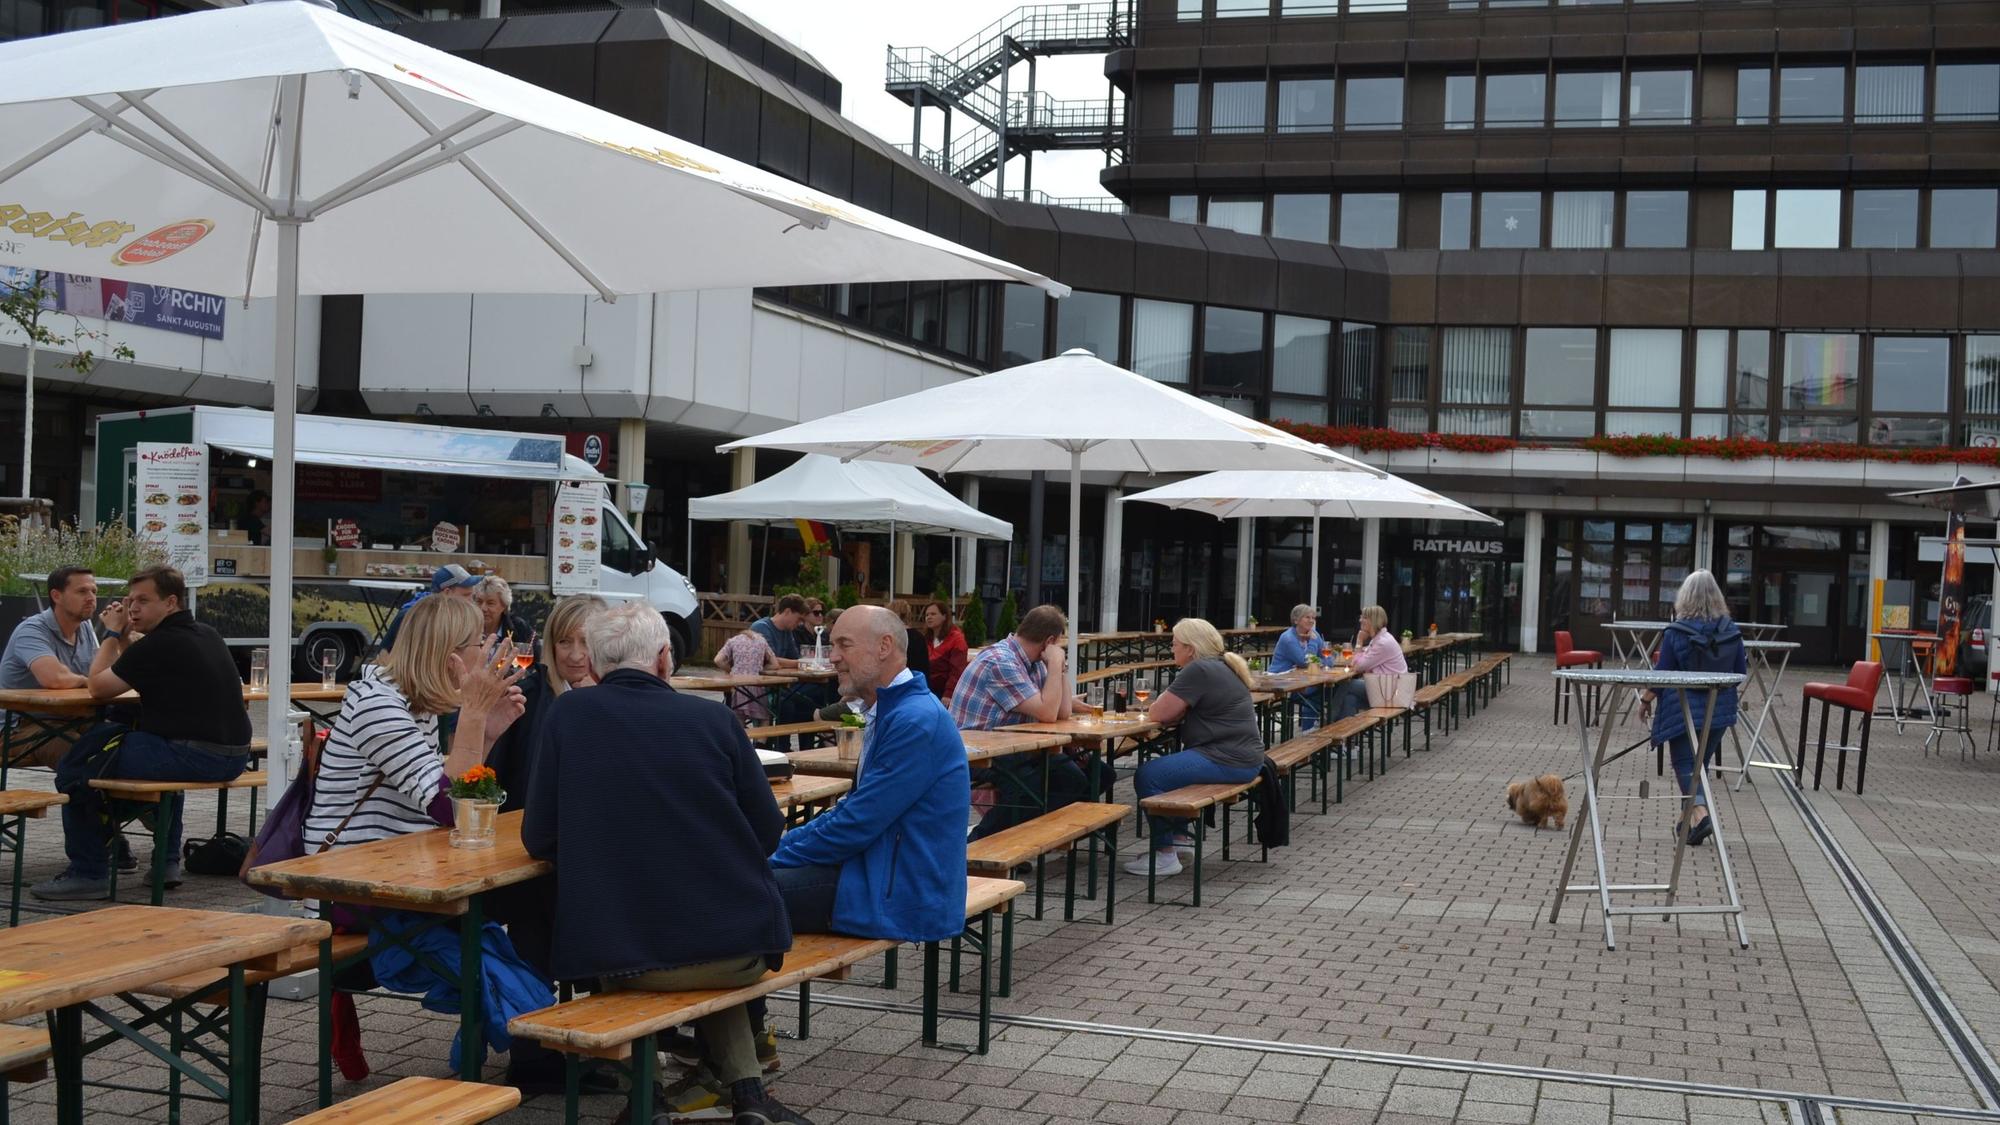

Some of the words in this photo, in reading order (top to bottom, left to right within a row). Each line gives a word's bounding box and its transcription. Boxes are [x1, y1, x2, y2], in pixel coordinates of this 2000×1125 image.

[156, 313, 182, 325] SANKT
[184, 319, 221, 333] AUGUSTIN
[150, 446, 202, 464] Knödelfein
[1413, 538, 1504, 554] RATHAUS
